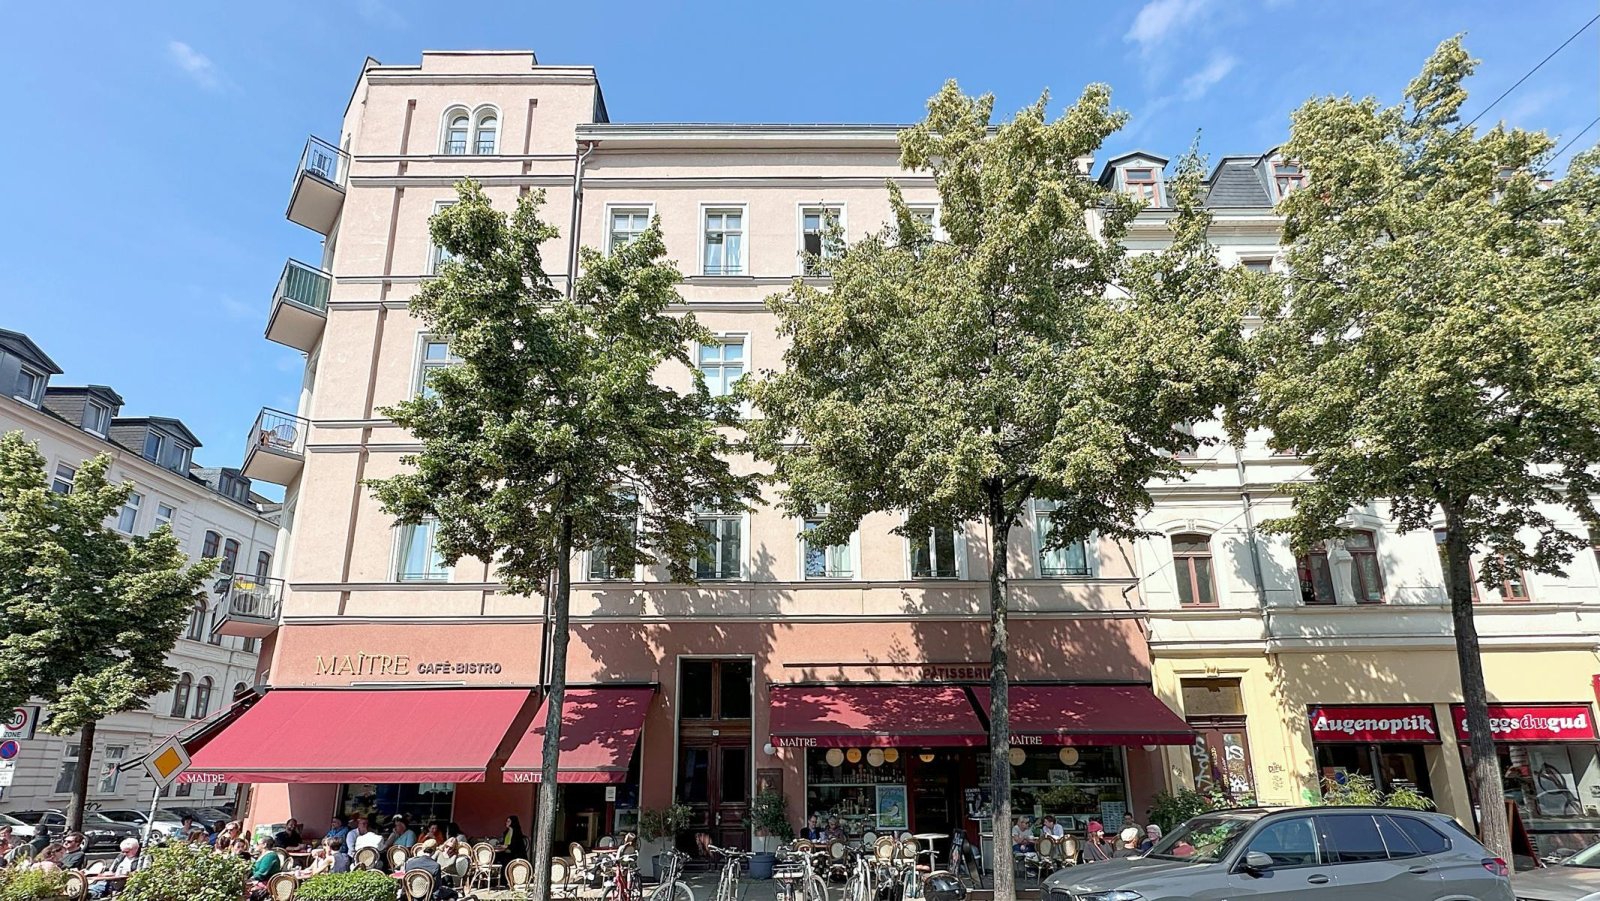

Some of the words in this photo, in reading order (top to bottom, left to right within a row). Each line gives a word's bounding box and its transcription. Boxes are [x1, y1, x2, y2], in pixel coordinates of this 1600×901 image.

[316, 651, 410, 676] MAÎTRE
[1314, 715, 1435, 735] Augenoptik
[779, 737, 817, 747] MAÎTRE
[186, 773, 226, 783] MAÎTRE
[514, 772, 543, 783] MAÎT
